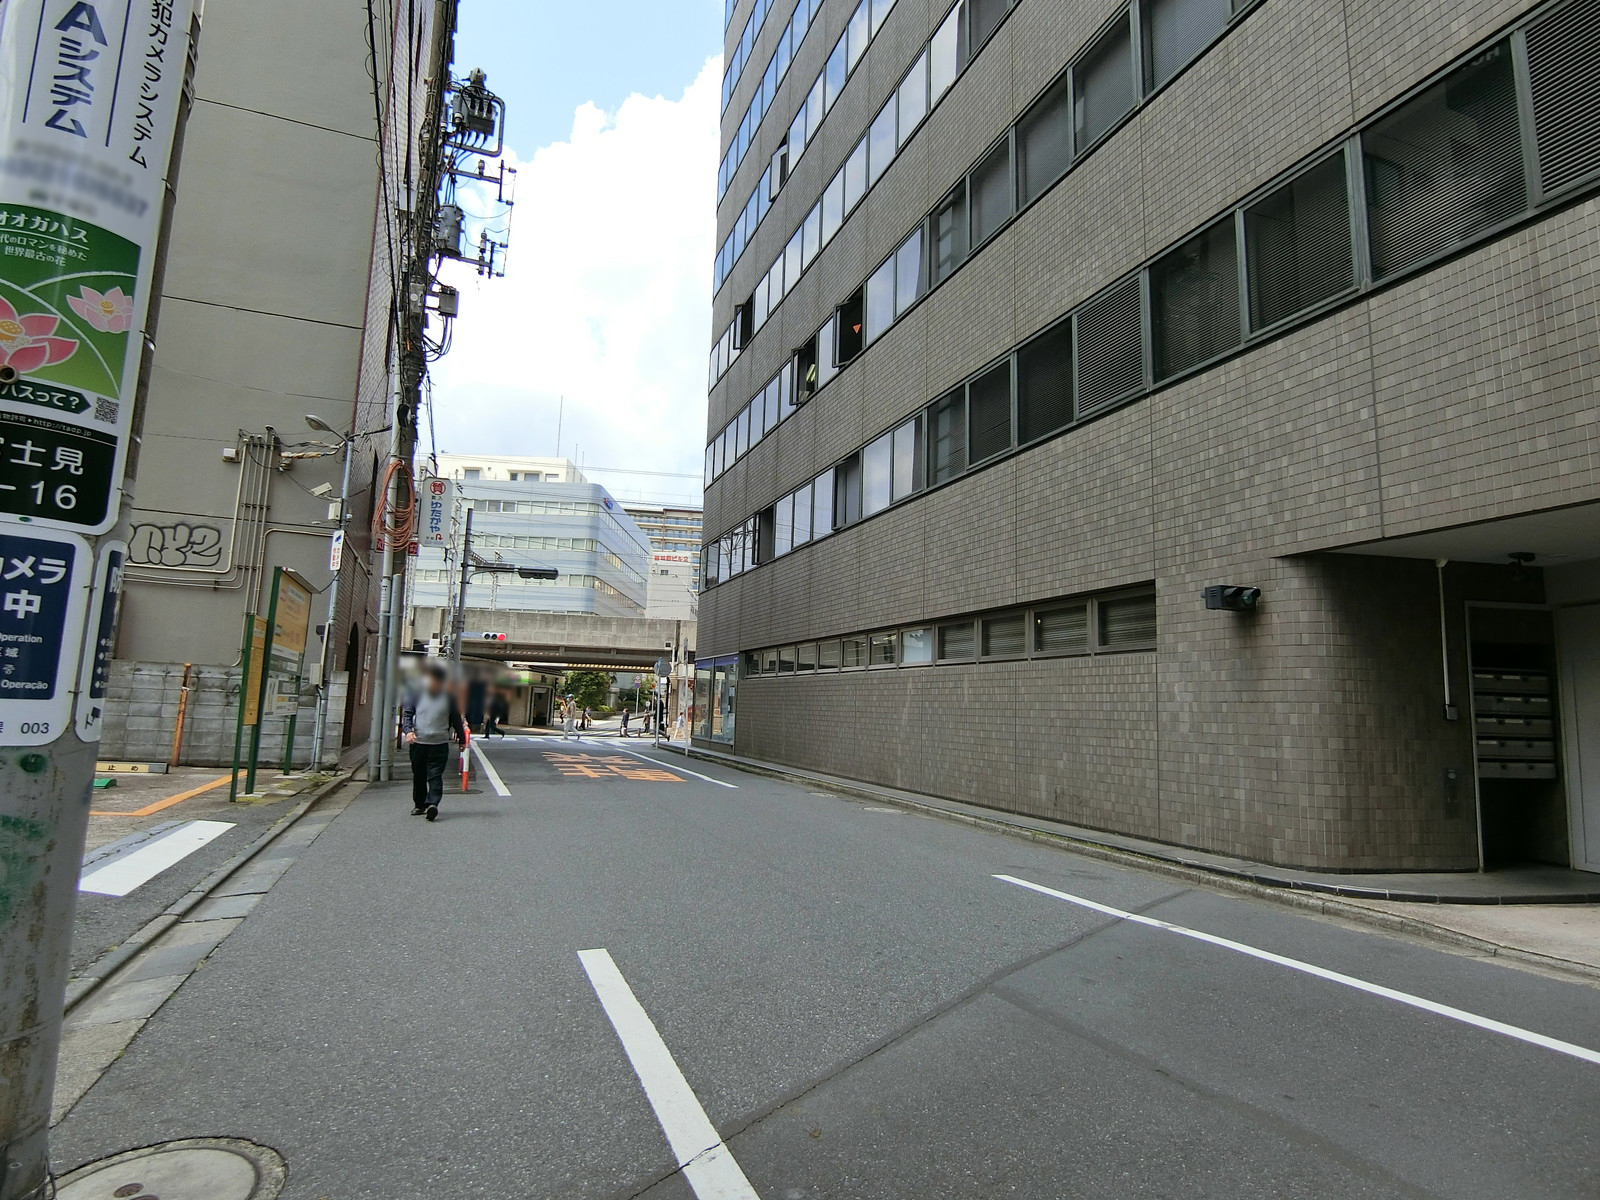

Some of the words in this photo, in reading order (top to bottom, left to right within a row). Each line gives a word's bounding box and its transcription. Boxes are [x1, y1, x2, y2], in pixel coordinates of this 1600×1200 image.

[129, 0, 174, 169] 犯カメラシステム
[4, 245, 67, 267] 世界最古の花
[0, 437, 84, 476] 士見
[0, 555, 67, 585] メラ
[3, 589, 42, 620] 中
[0, 632, 43, 644] peration
[1, 679, 49, 690] Operação
[20, 722, 50, 734] 003
